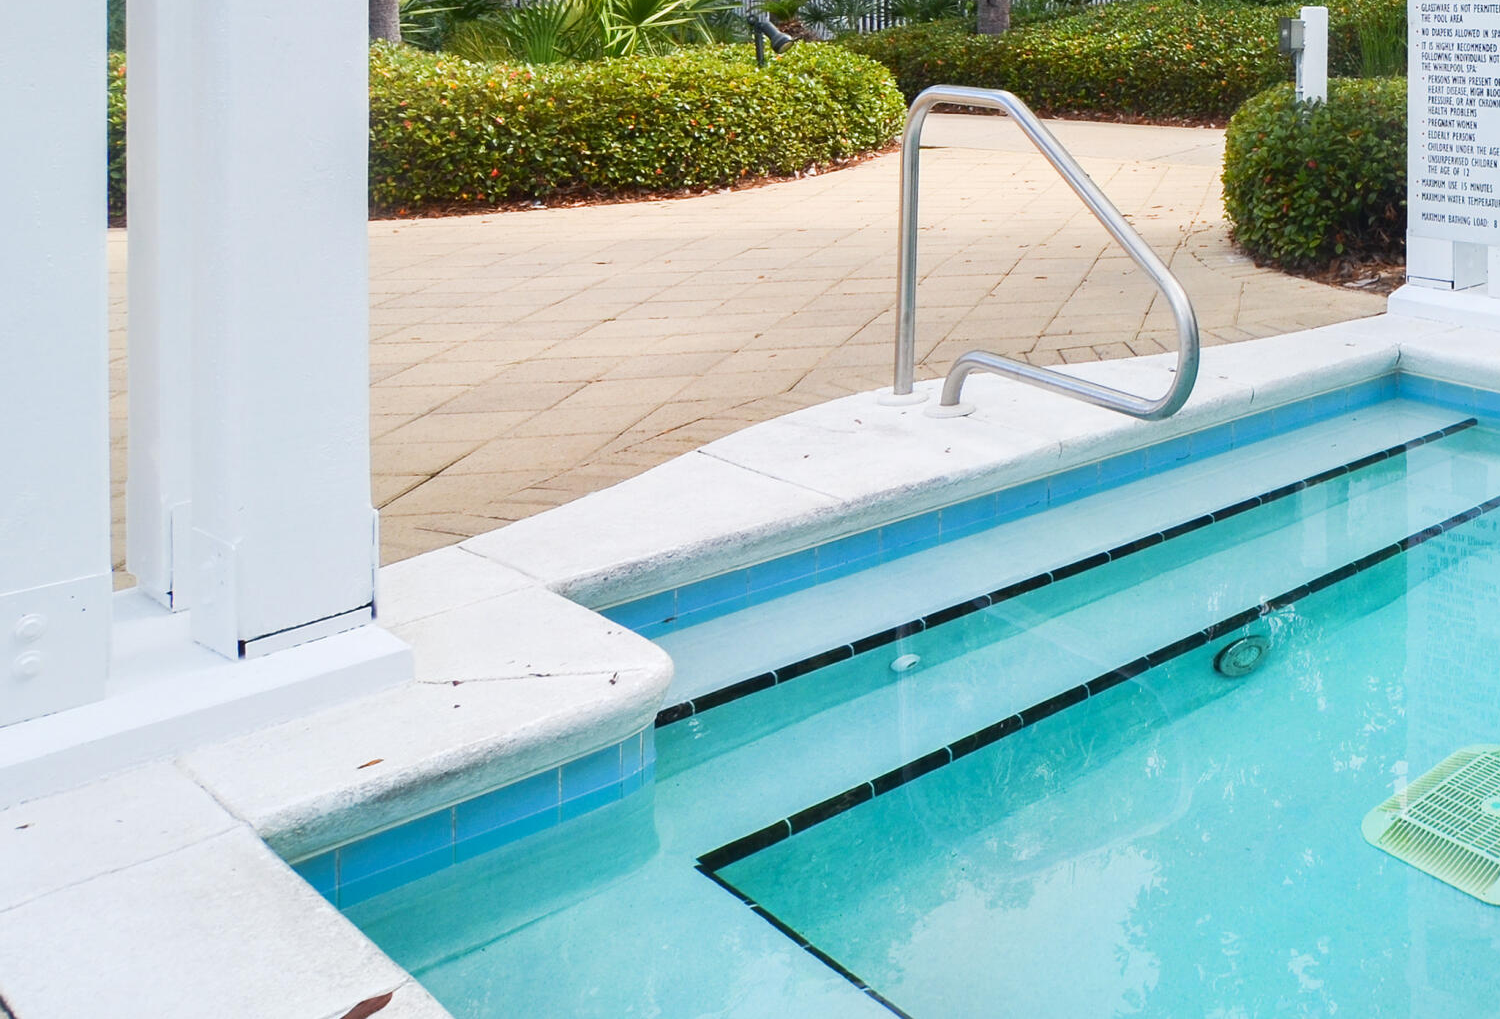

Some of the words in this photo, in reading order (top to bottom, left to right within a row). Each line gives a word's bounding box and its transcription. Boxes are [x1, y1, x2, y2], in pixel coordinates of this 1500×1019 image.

[1421, 3, 1450, 12] GLASSWARE
[1453, 4, 1458, 12] IS
[1460, 4, 1471, 13] NOT
[1421, 14, 1431, 22] THE
[1434, 14, 1447, 23] POOL
[1450, 14, 1463, 23] AREA
[1421, 28, 1429, 37] NO
[1432, 28, 1453, 37] DIAPERS
[1455, 29, 1480, 38] ALLOWED
[1483, 29, 1489, 38] IN
[1491, 29, 1500, 38] SPA
[1421, 41, 1426, 50] IT
[1428, 42, 1433, 50] IS
[1435, 42, 1454, 51] HIGHLY
[1457, 43, 1498, 53] RECOMMENDED
[1421, 52, 1452, 62] FOLLOWING
[1454, 53, 1486, 63] INDIVIDUALS
[1489, 54, 1500, 64] NOT
[1421, 62, 1431, 71] THE
[1433, 62, 1464, 73] WHIRLPOOL
[1428, 75, 1450, 85] PERSONS
[1452, 76, 1466, 85] WITH
[1468, 76, 1491, 86] PRESENT
[1427, 86, 1444, 95] HEART
[1470, 87, 1484, 97] HIGH
[1456, 97, 1464, 106] OR
[1466, 98, 1476, 107] ANY
[1427, 106, 1448, 116] HEALTH
[1450, 108, 1477, 117] PROBLEMS
[1428, 118, 1455, 128] PREGNANT
[1456, 120, 1477, 130] WOMEN
[1428, 130, 1449, 140] ELDERLY
[1452, 132, 1476, 142] PERSONS
[1427, 142, 1453, 152] CHILDREN
[1456, 144, 1474, 155] UNDER
[1477, 146, 1487, 155] THE
[1489, 147, 1499, 156] AGE
[1471, 159, 1498, 168] CHILDREN
[1428, 165, 1437, 174] THE
[1440, 166, 1450, 175] AGE
[1452, 167, 1460, 176] OF
[1464, 168, 1470, 177] 12
[1421, 178, 1446, 188] MAXIMUM
[1448, 180, 1457, 190] USE
[1461, 181, 1467, 191] 15
[1470, 183, 1493, 193] MINUTES
[1421, 192, 1446, 202] MAXIMUM
[1448, 195, 1465, 204] WATER
[1421, 212, 1446, 223] MAXIMUM
[1448, 214, 1471, 226] BATHING
[1493, 220, 1498, 228] 8
